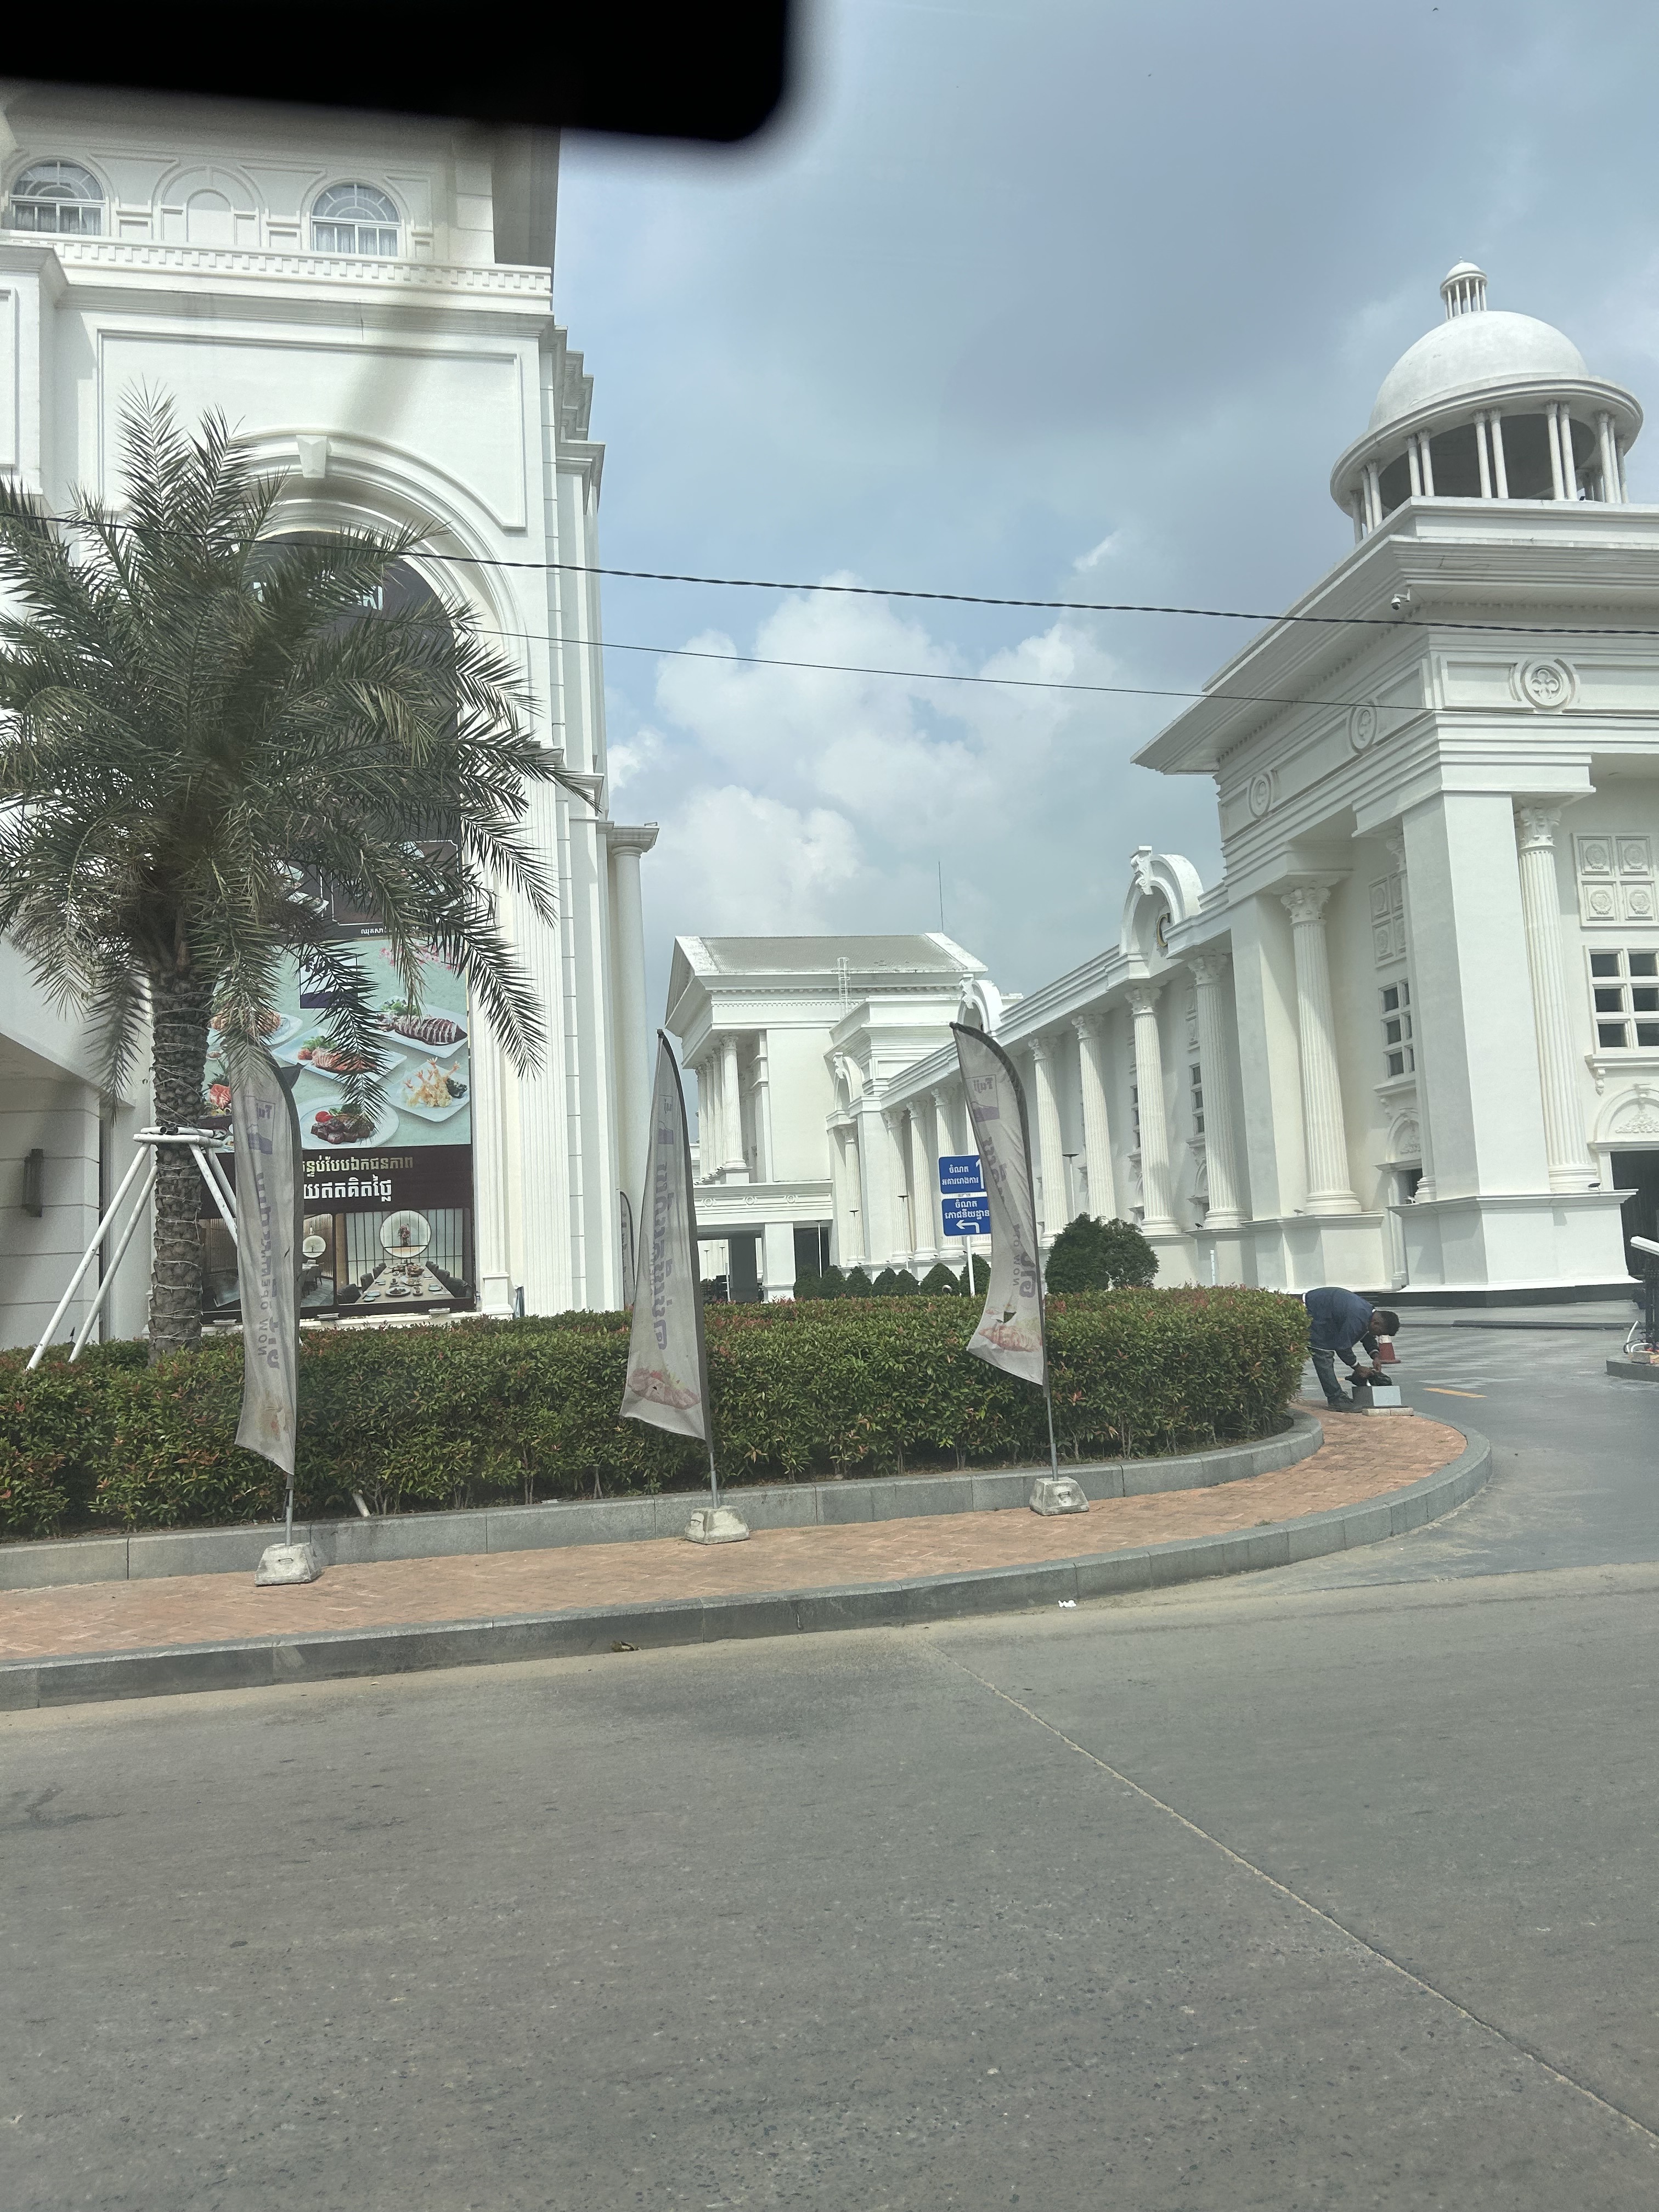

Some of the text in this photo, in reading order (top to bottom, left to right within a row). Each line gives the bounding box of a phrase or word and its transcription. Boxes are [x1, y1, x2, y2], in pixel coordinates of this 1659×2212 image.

[302, 1155, 413, 1178] ន្ទប់បែបឯកជនភាព
[949, 1164, 969, 1173] ចំណត
[303, 1174, 392, 1202] យឥតគិតថ្លៃ
[955, 1199, 978, 1208] ចំណត
